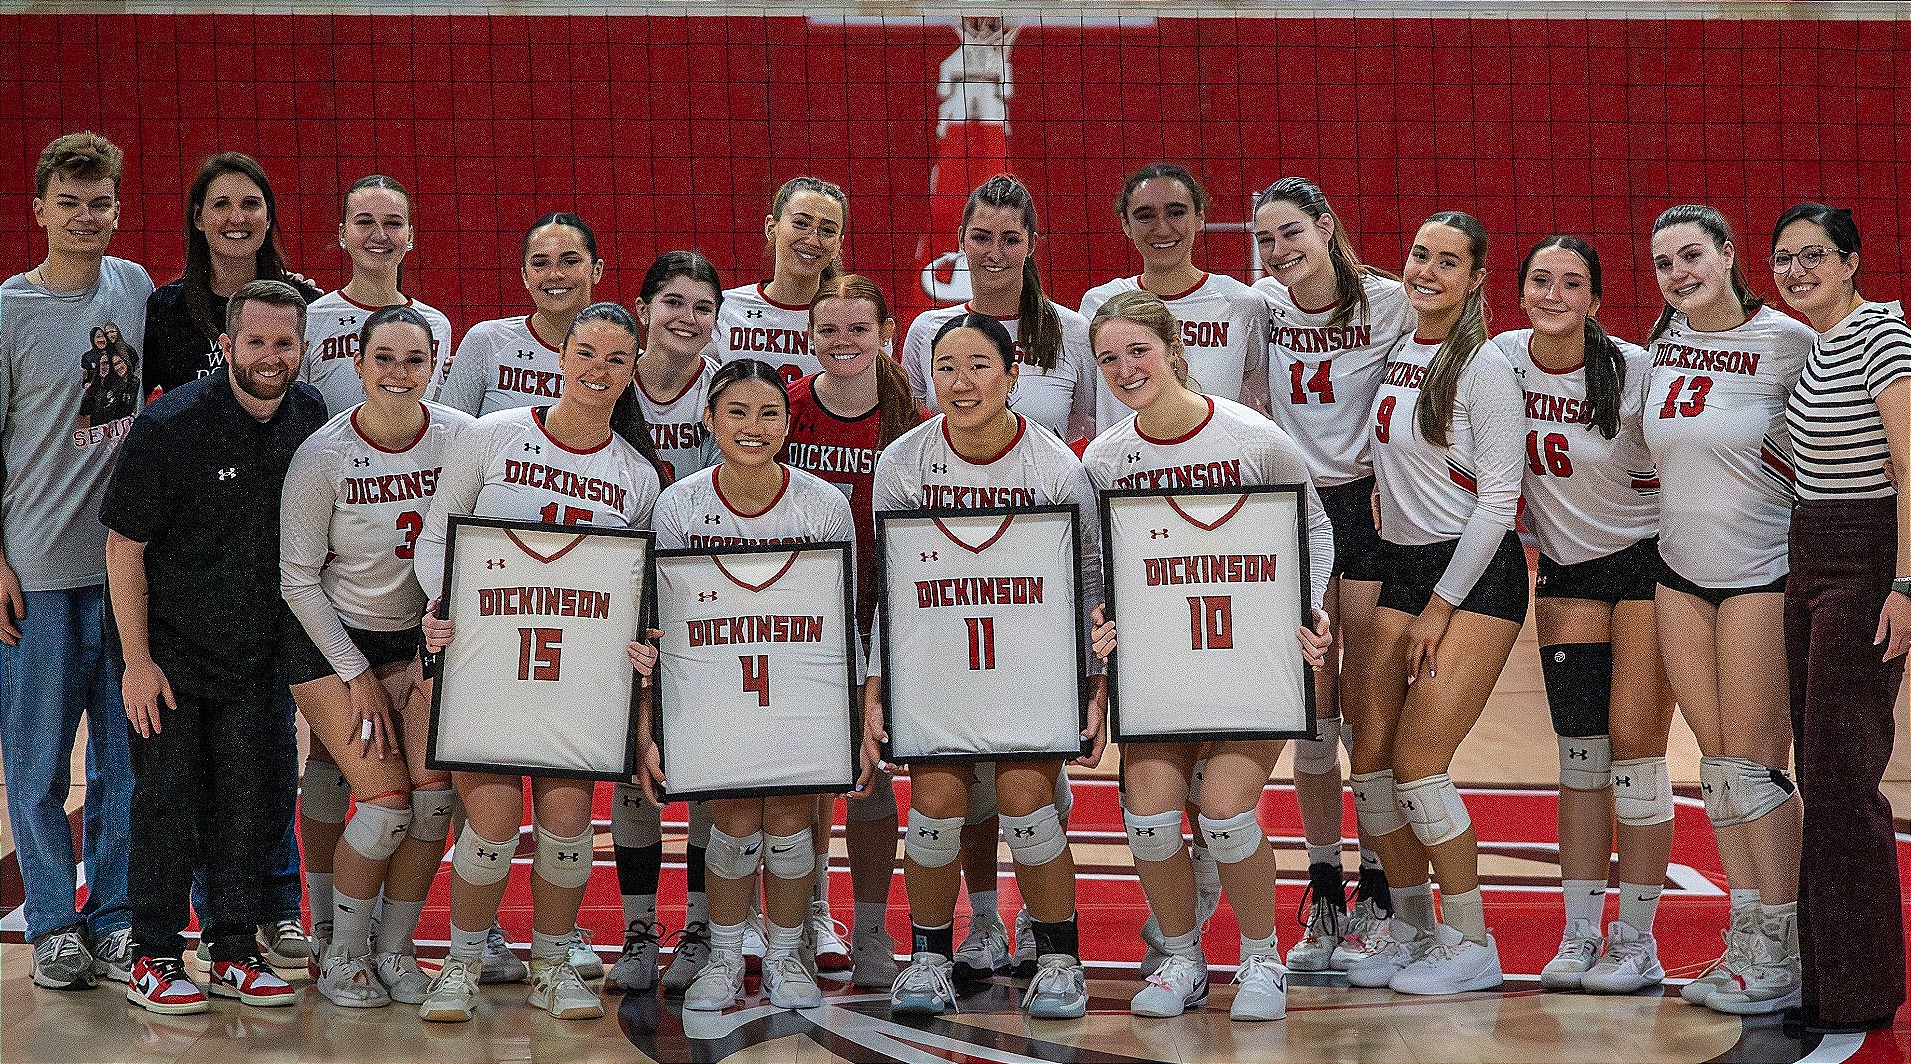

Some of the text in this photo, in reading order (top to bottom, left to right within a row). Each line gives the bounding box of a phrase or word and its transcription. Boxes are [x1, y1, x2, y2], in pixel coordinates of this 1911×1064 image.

[729, 327, 816, 356] DICKIN
[498, 365, 565, 398] DICKI
[1289, 360, 1335, 404] 14
[1659, 376, 1713, 419] 13
[1375, 396, 1396, 444] 9
[788, 443, 883, 473] DICKINS
[1526, 430, 1573, 478] 16
[344, 467, 442, 504] DICKINS
[503, 459, 627, 513] DICKINSON
[395, 511, 423, 559] 3
[1143, 554, 1277, 586] DICKINSON
[478, 587, 610, 619] DICKINSON
[914, 577, 1043, 608] DICKINSON
[686, 615, 823, 647] DICKINSON
[963, 617, 995, 670] 11
[1186, 595, 1233, 650] 10
[518, 627, 563, 681] 15
[738, 655, 770, 706] 4
